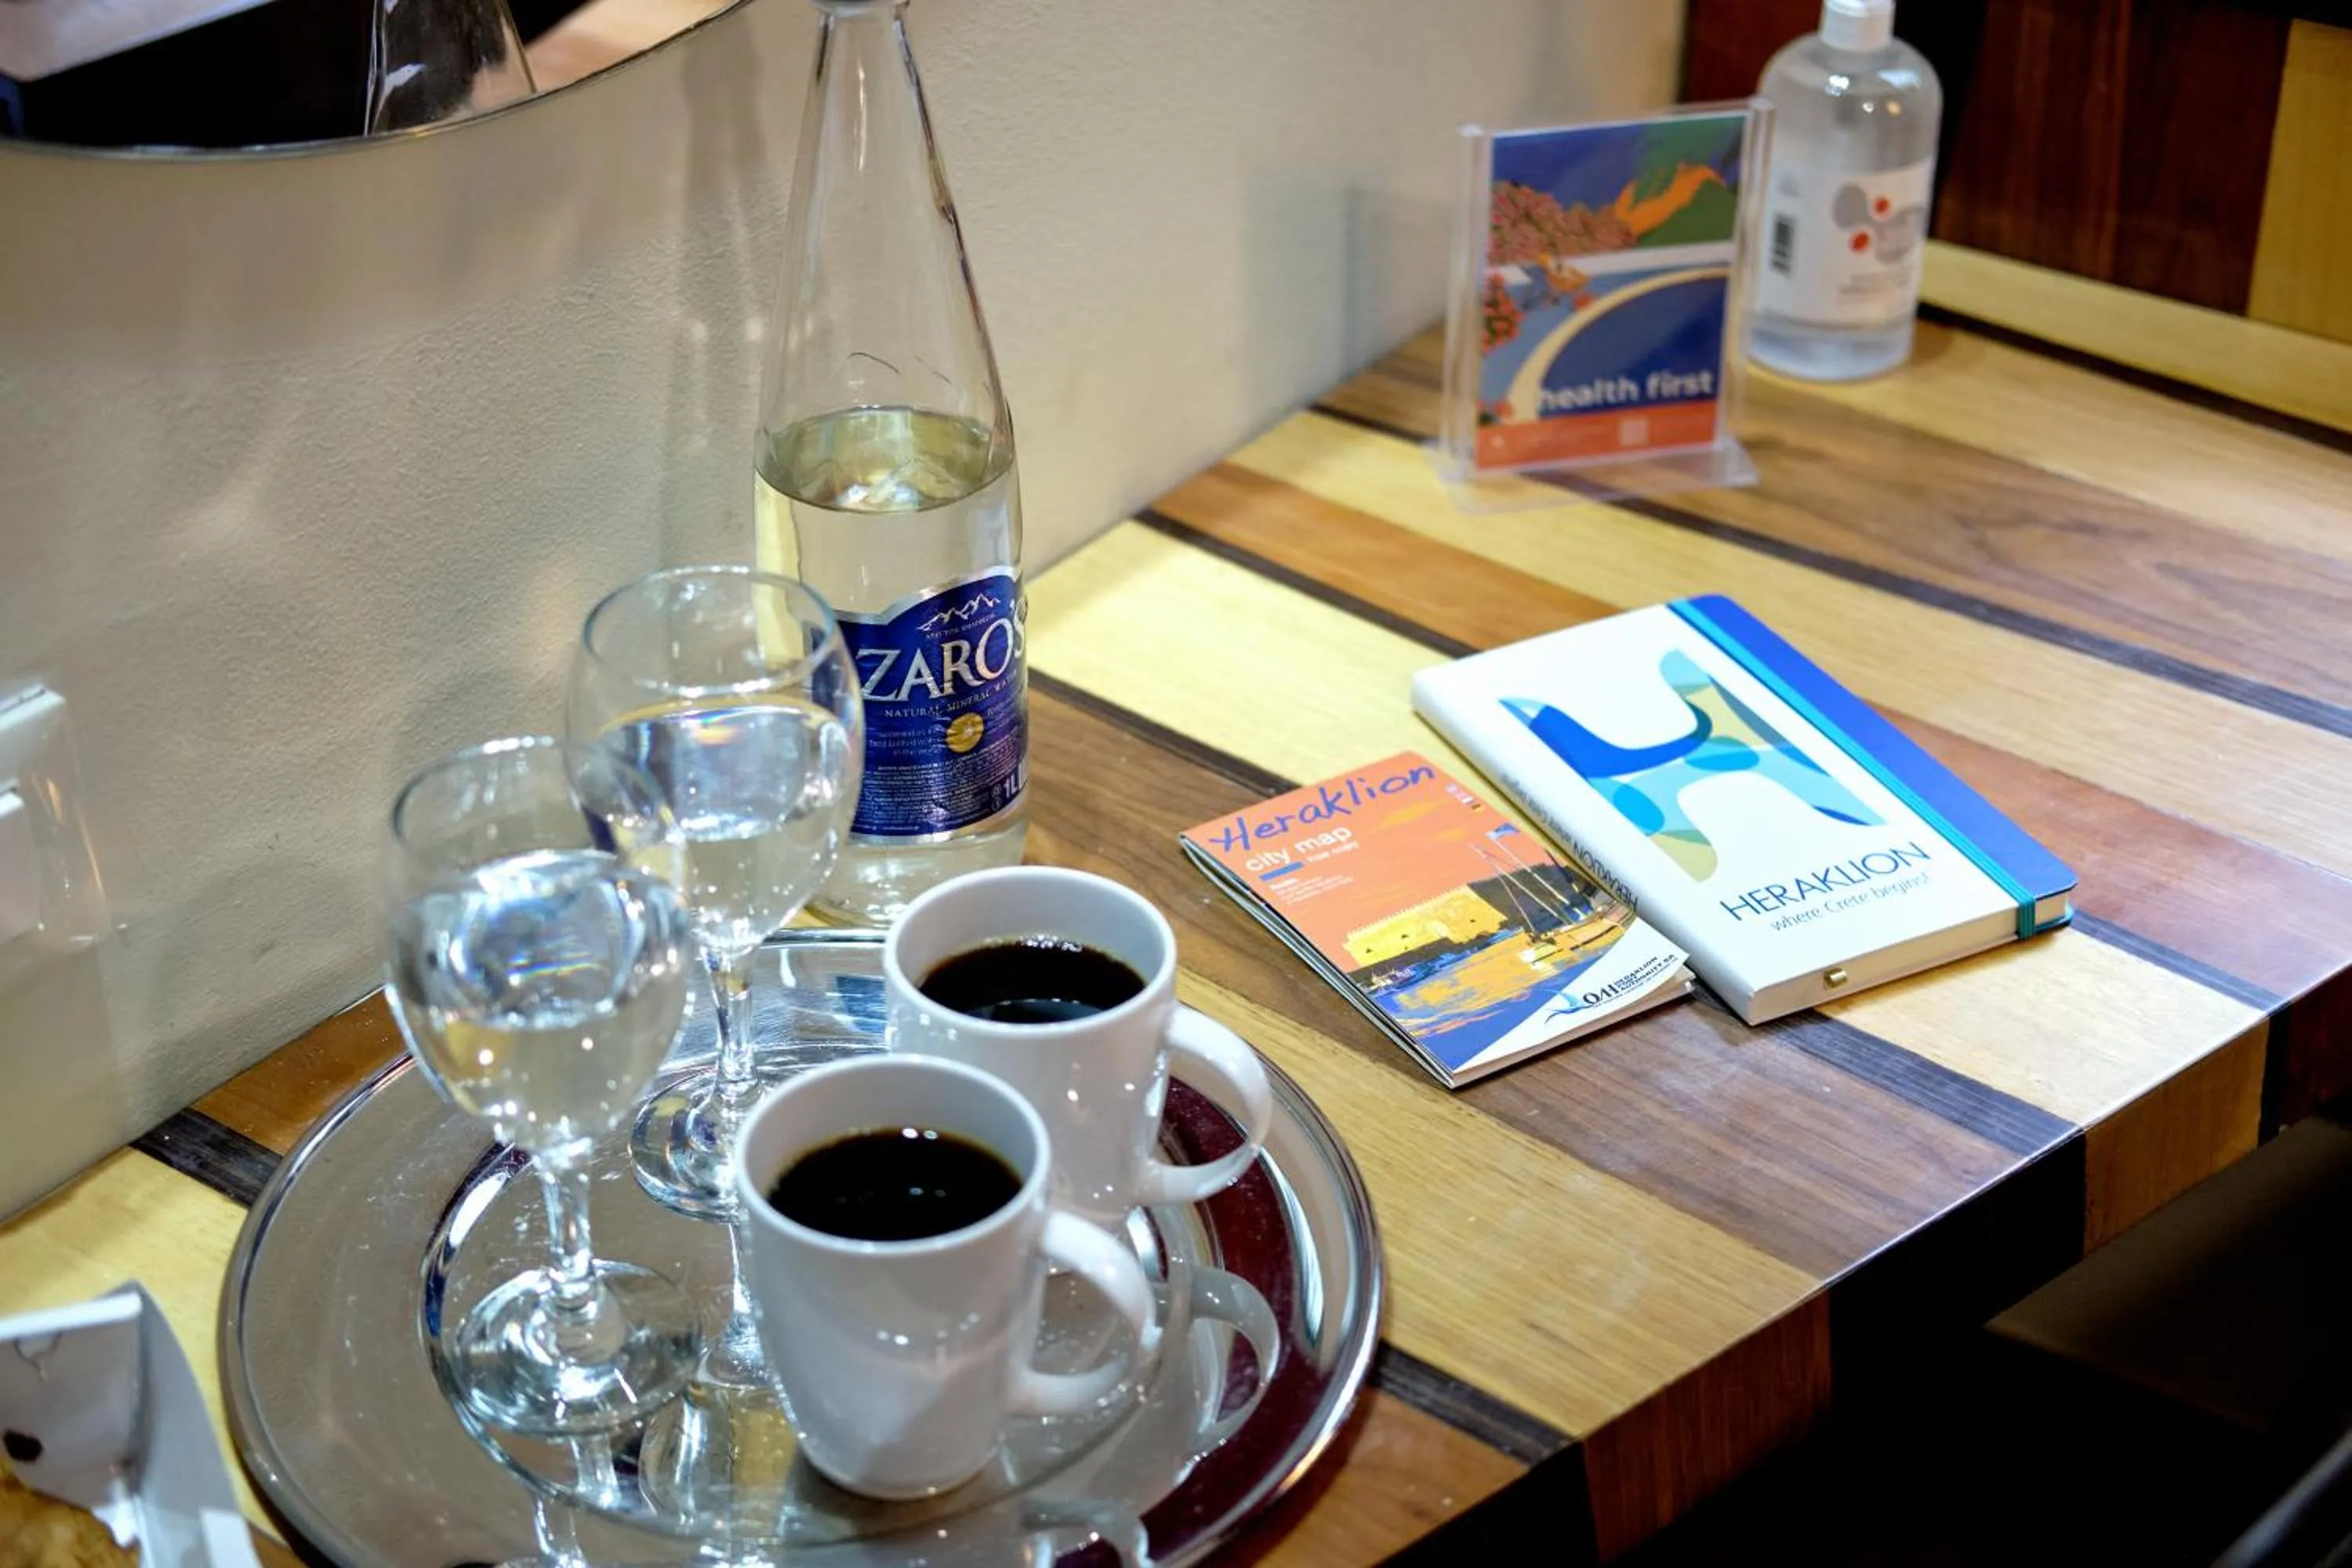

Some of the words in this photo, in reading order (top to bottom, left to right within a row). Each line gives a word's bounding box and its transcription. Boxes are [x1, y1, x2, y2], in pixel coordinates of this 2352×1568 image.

[1647, 369, 1715, 400] first
[884, 706, 941, 719] NATURAL
[947, 689, 991, 712] MINERAL
[1209, 765, 1436, 851] Heraklion
[1294, 827, 1352, 854] map
[1573, 840, 1640, 912] HERAKLION
[1719, 840, 1932, 921] HERAKLION
[1770, 909, 1820, 931] where
[1824, 891, 1869, 915] Crete
